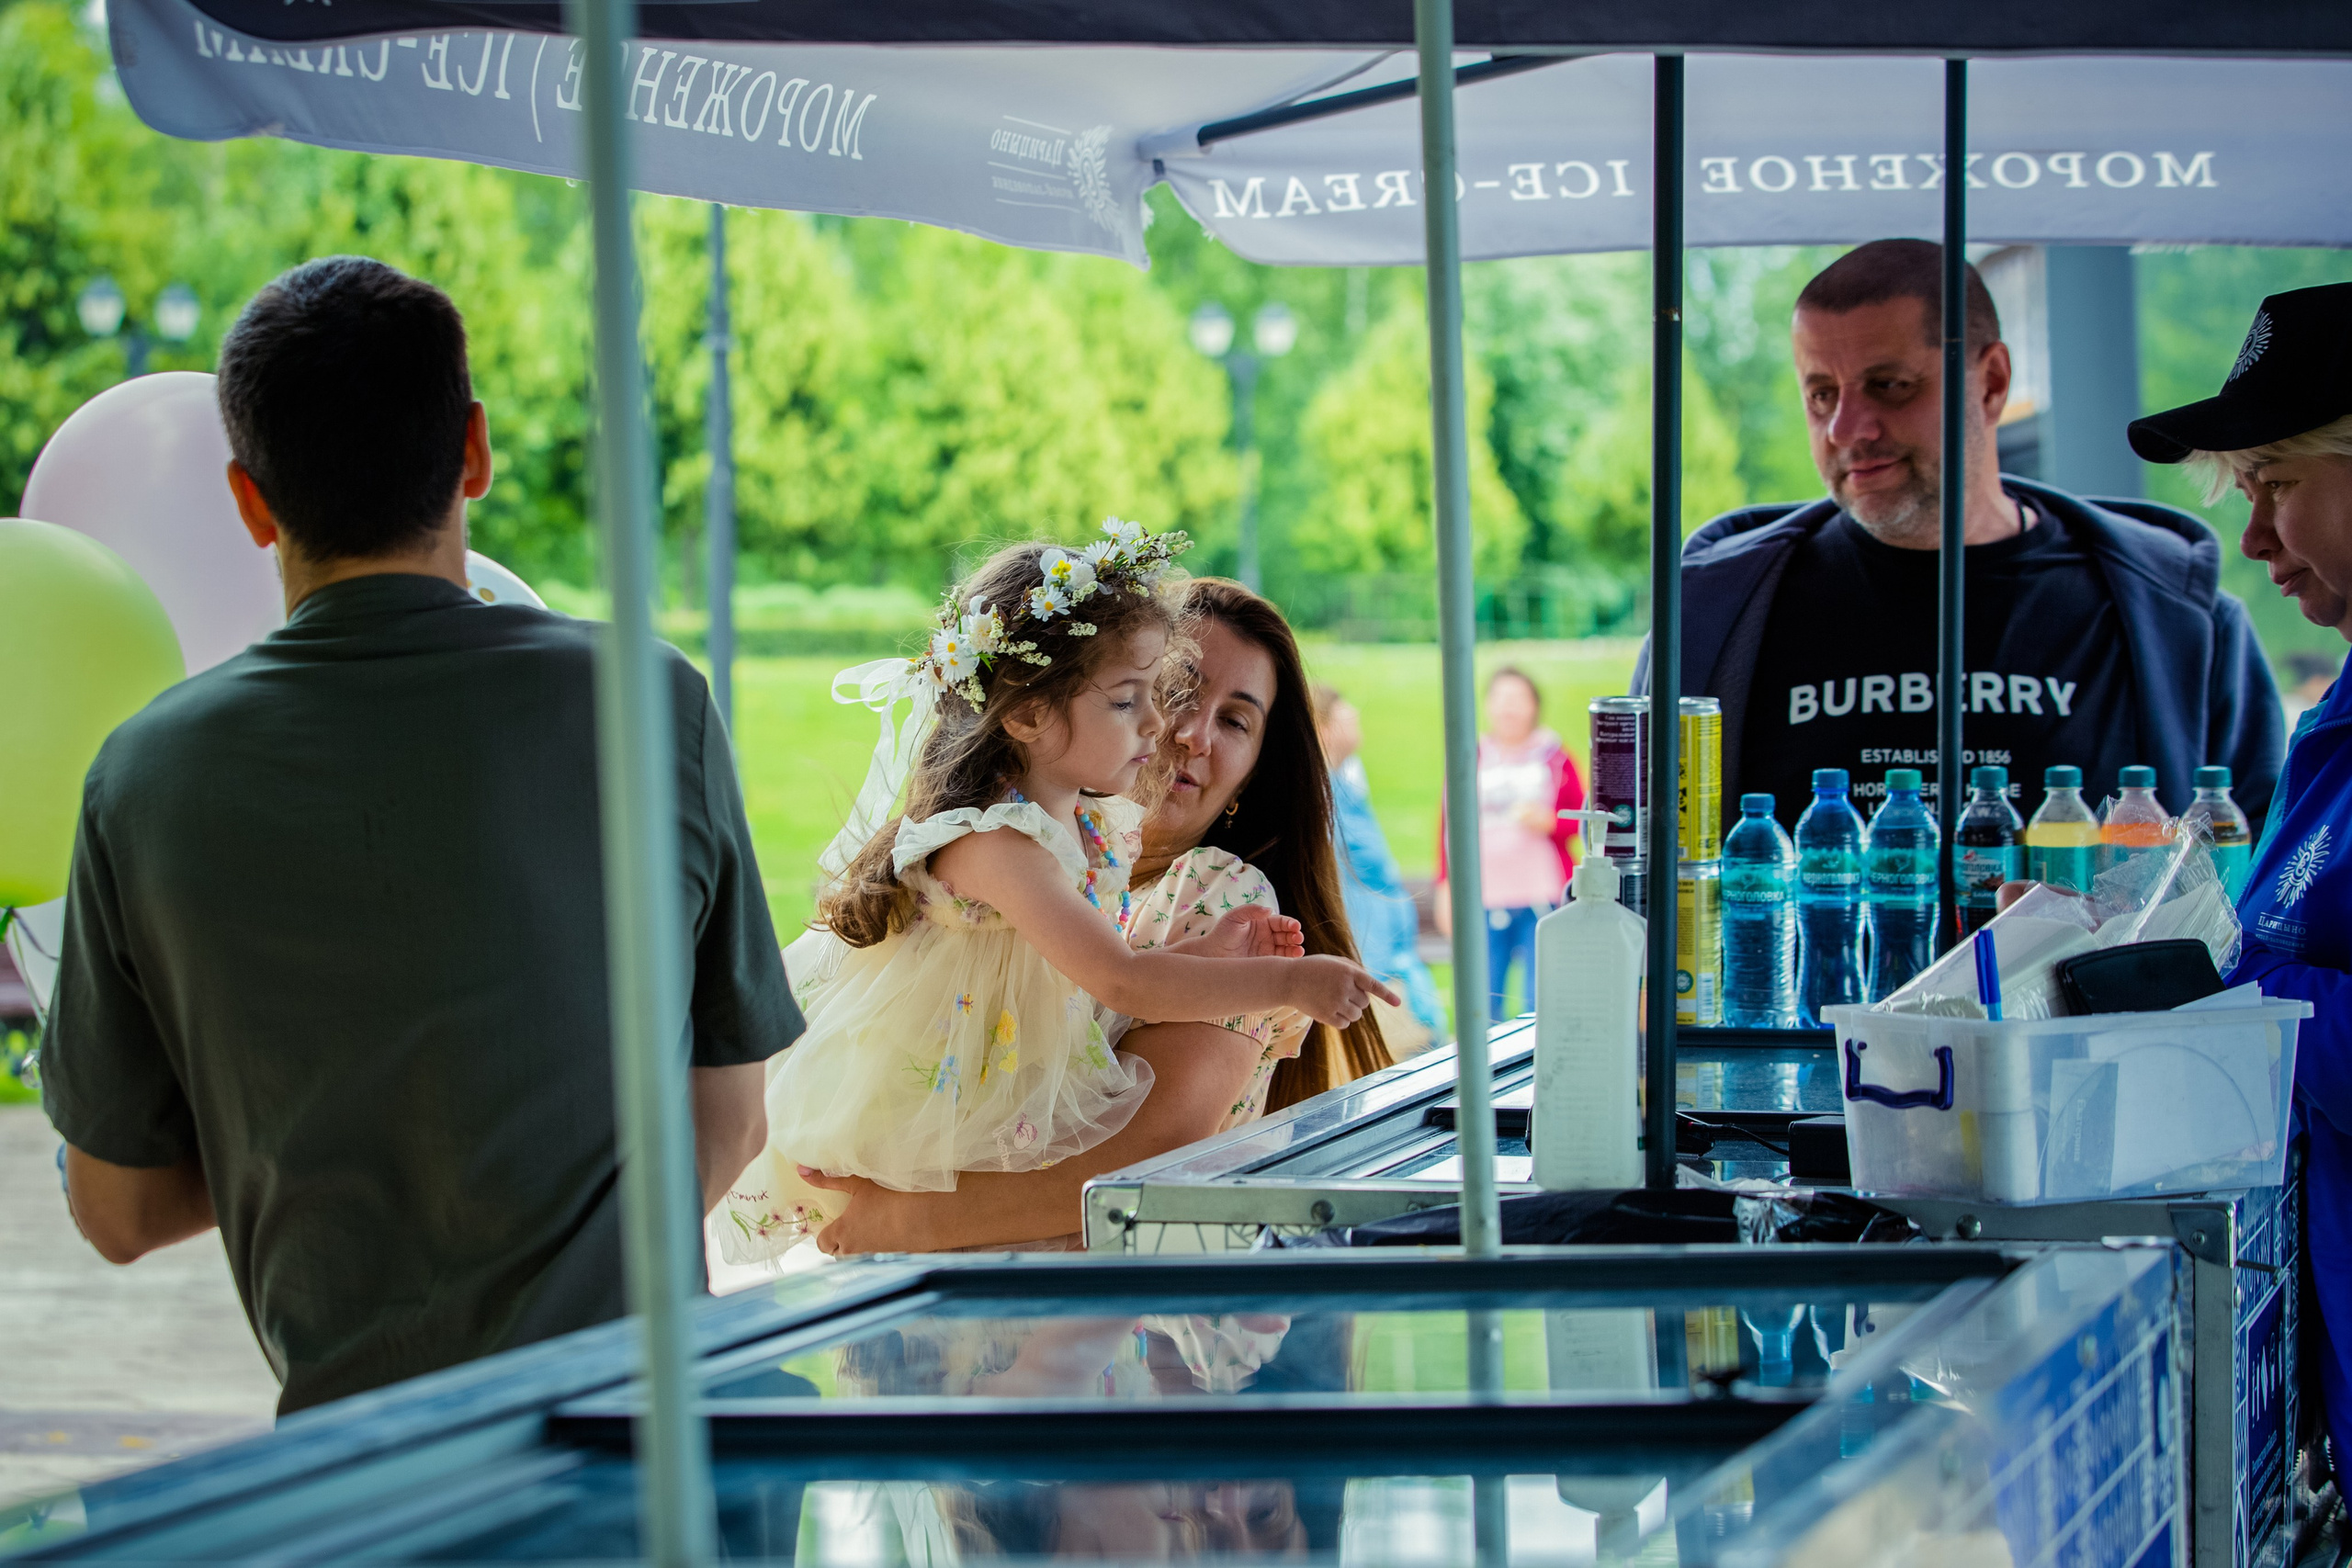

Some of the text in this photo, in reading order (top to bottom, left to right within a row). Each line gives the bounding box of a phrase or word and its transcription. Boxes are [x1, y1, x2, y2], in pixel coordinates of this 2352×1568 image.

[1789, 671, 2076, 726] BURBRRY
[1860, 749, 2012, 764] ESTABLISD 1856
